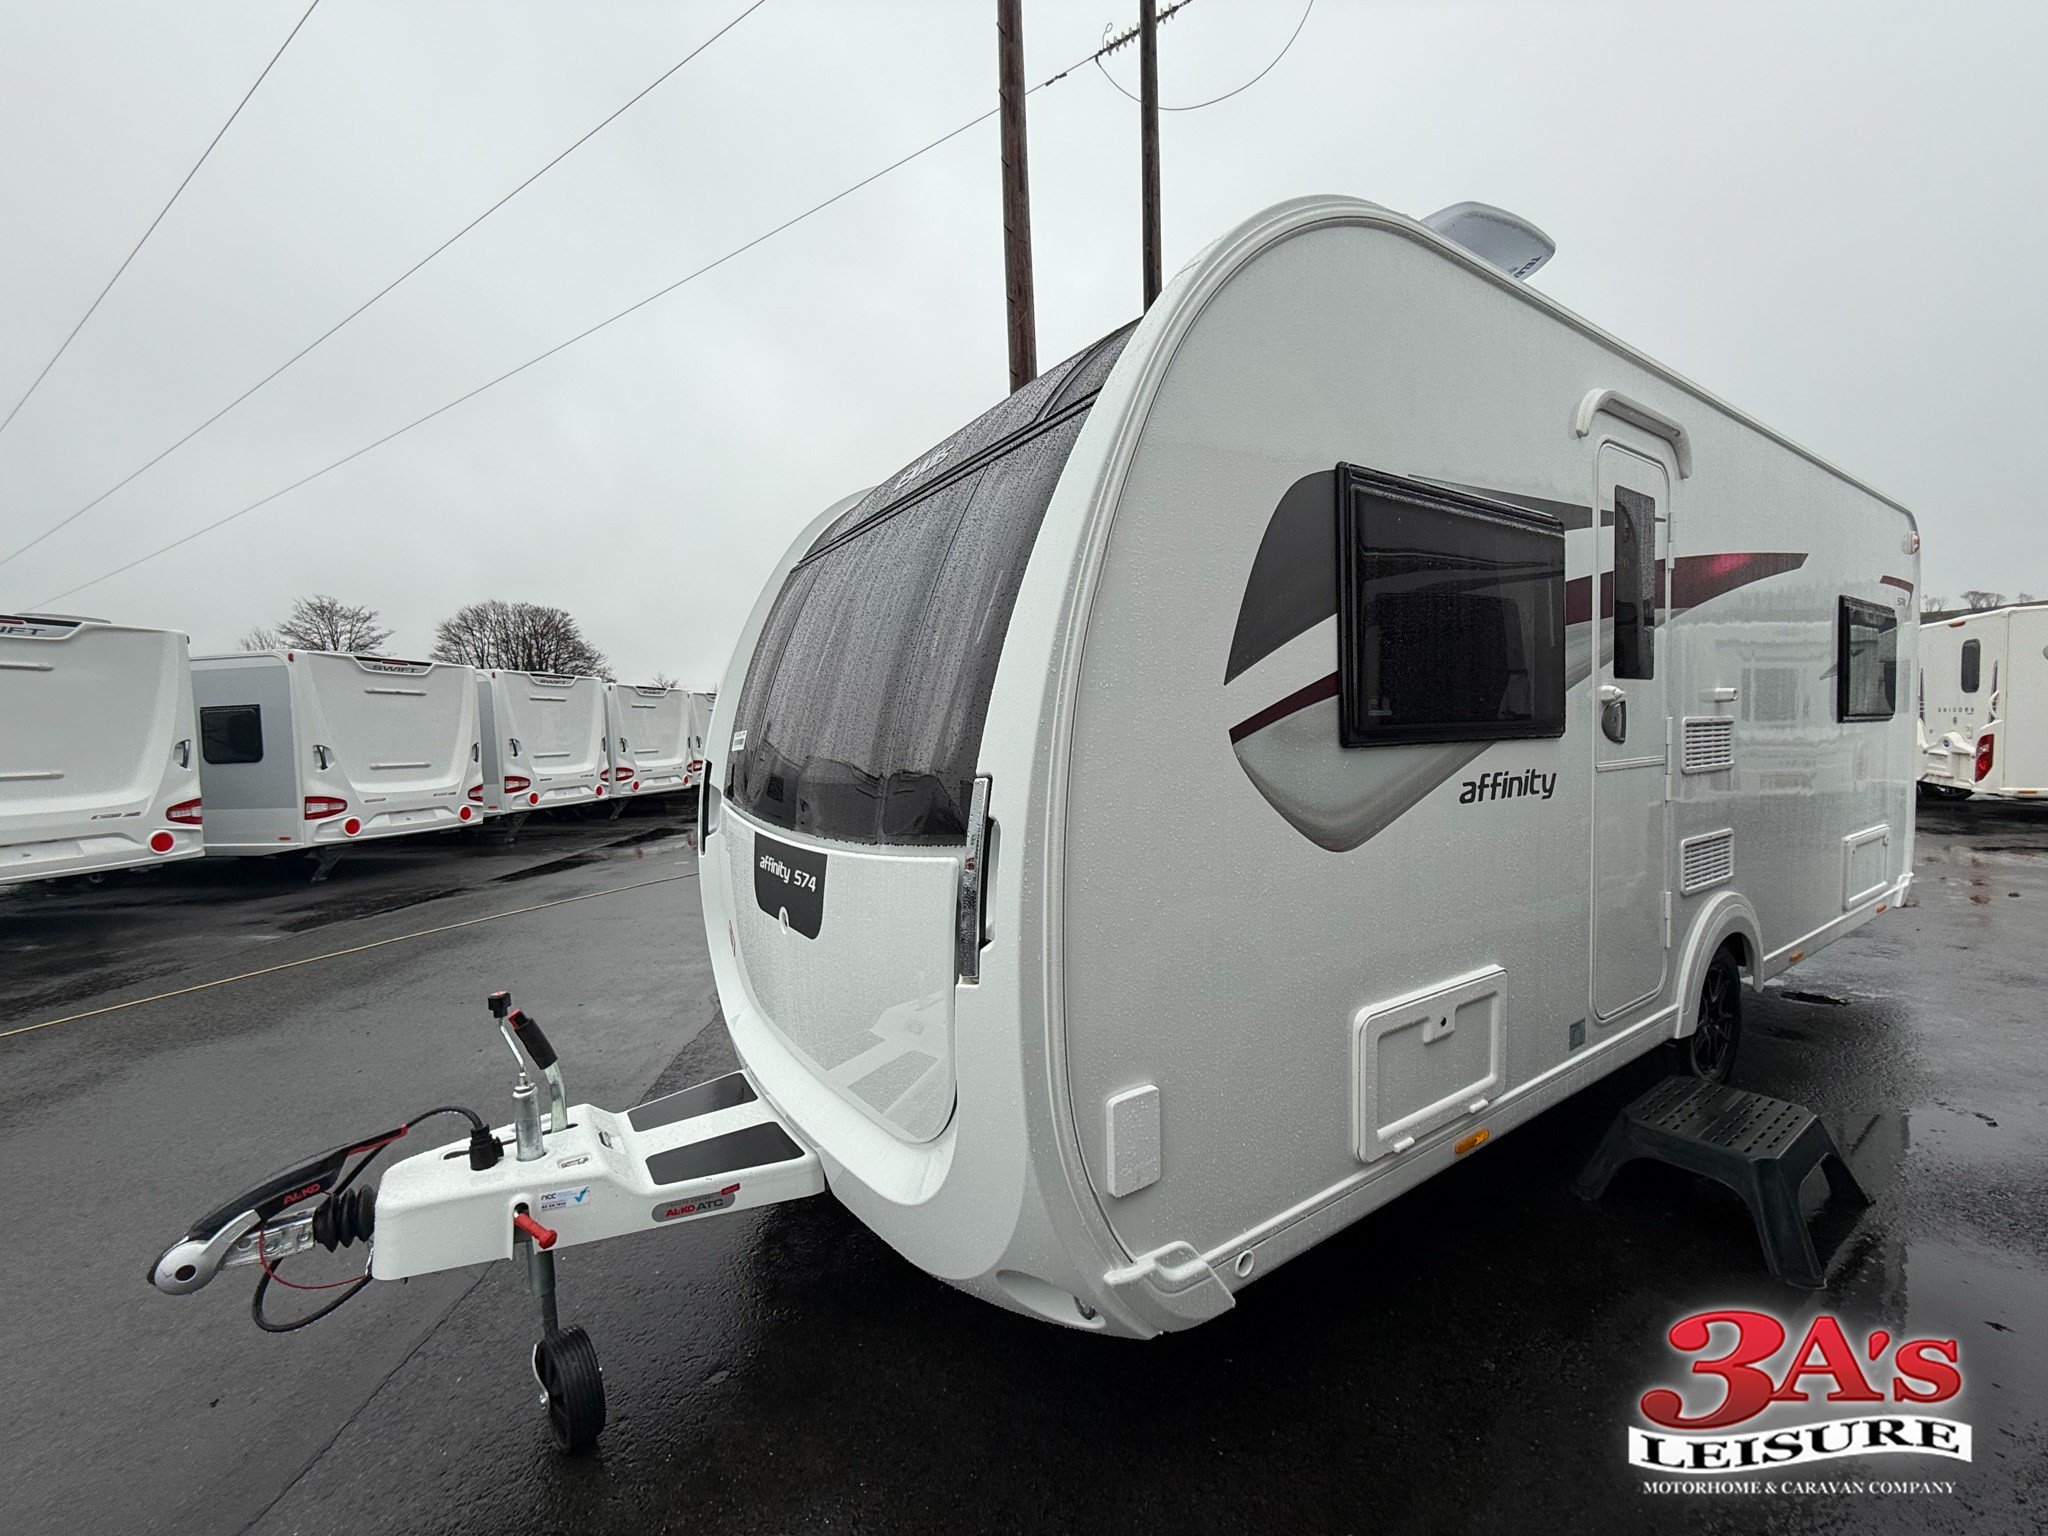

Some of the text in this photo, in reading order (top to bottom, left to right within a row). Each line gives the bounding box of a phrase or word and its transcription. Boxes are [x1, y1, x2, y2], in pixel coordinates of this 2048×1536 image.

[372, 664, 418, 673] SWIFT
[1459, 768, 1557, 804] affinity
[759, 854, 817, 892] affinity 574
[697, 1199, 723, 1211] ATC
